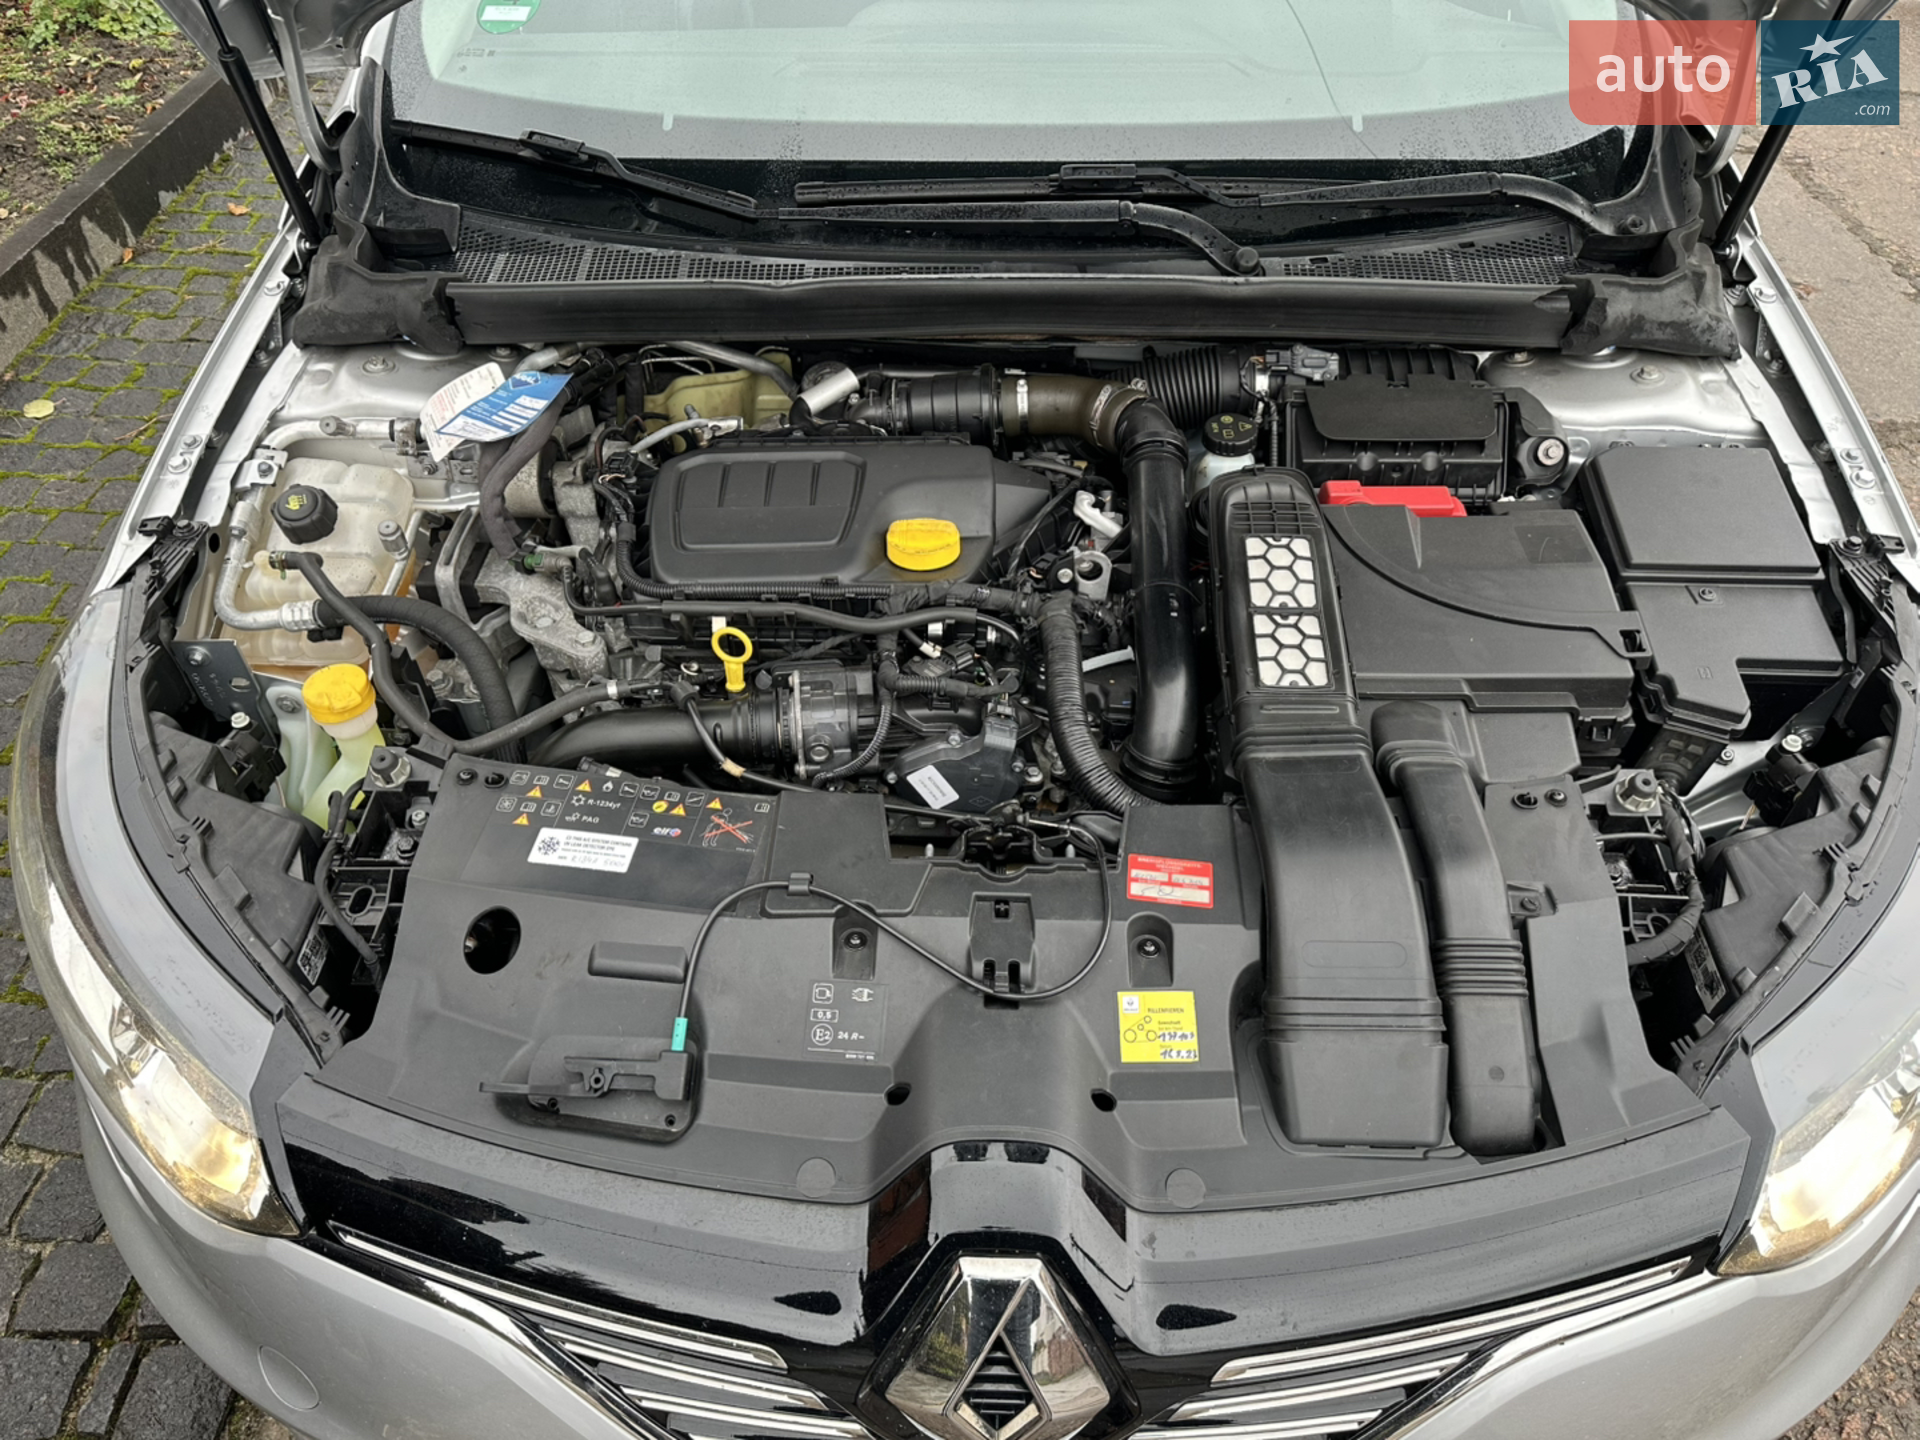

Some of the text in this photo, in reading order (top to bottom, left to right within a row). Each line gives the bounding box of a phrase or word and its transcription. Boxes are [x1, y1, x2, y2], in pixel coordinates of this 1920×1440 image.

[587, 799, 622, 810] R-1234yf
[581, 815, 600, 824] PAG
[652, 827, 670, 836] elf
